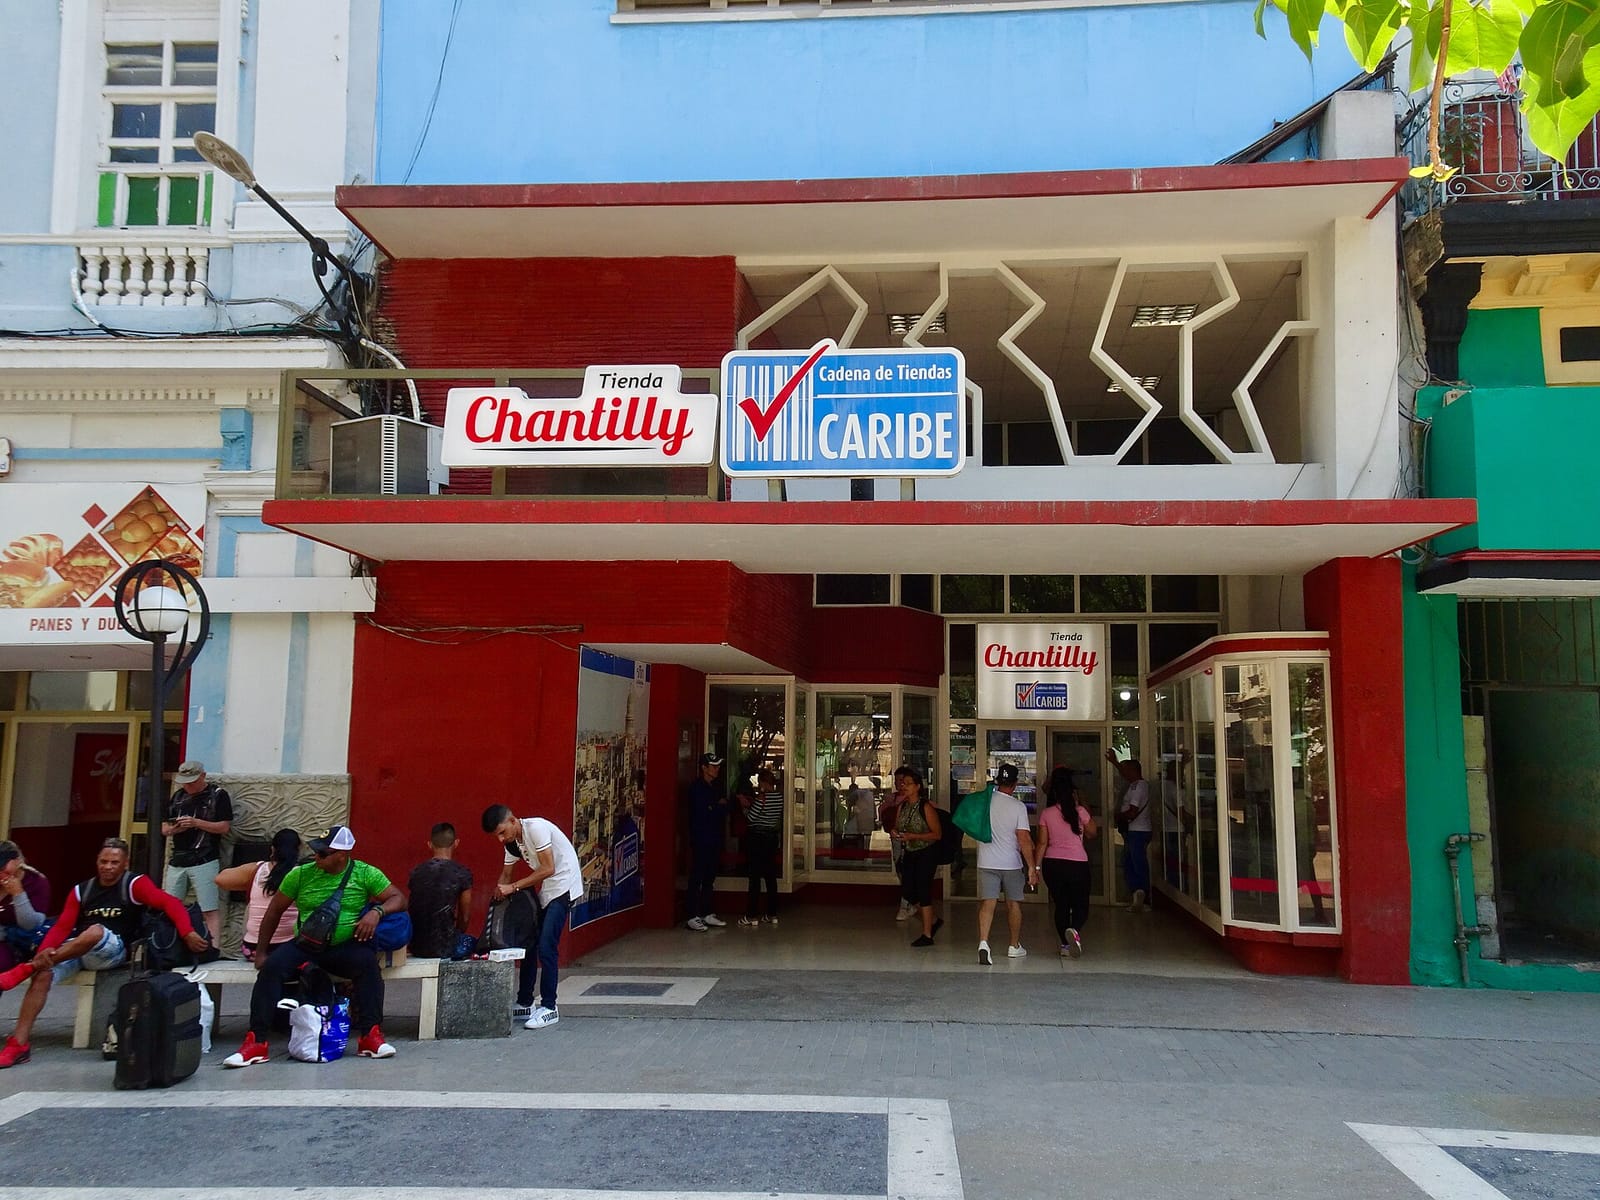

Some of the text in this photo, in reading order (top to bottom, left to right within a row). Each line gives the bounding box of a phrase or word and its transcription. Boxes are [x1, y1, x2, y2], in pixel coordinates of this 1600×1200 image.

[600, 373, 663, 389] Tienda
[819, 364, 952, 382] Cadena de Tiendas
[465, 396, 693, 456] Chantilly
[818, 412, 953, 460] CARIBE
[29, 618, 72, 631] PANES
[81, 618, 90, 630] Y
[1050, 632, 1083, 641] Tienda
[984, 644, 1099, 675] Chantilly
[1035, 695, 1067, 709] CARIBE
